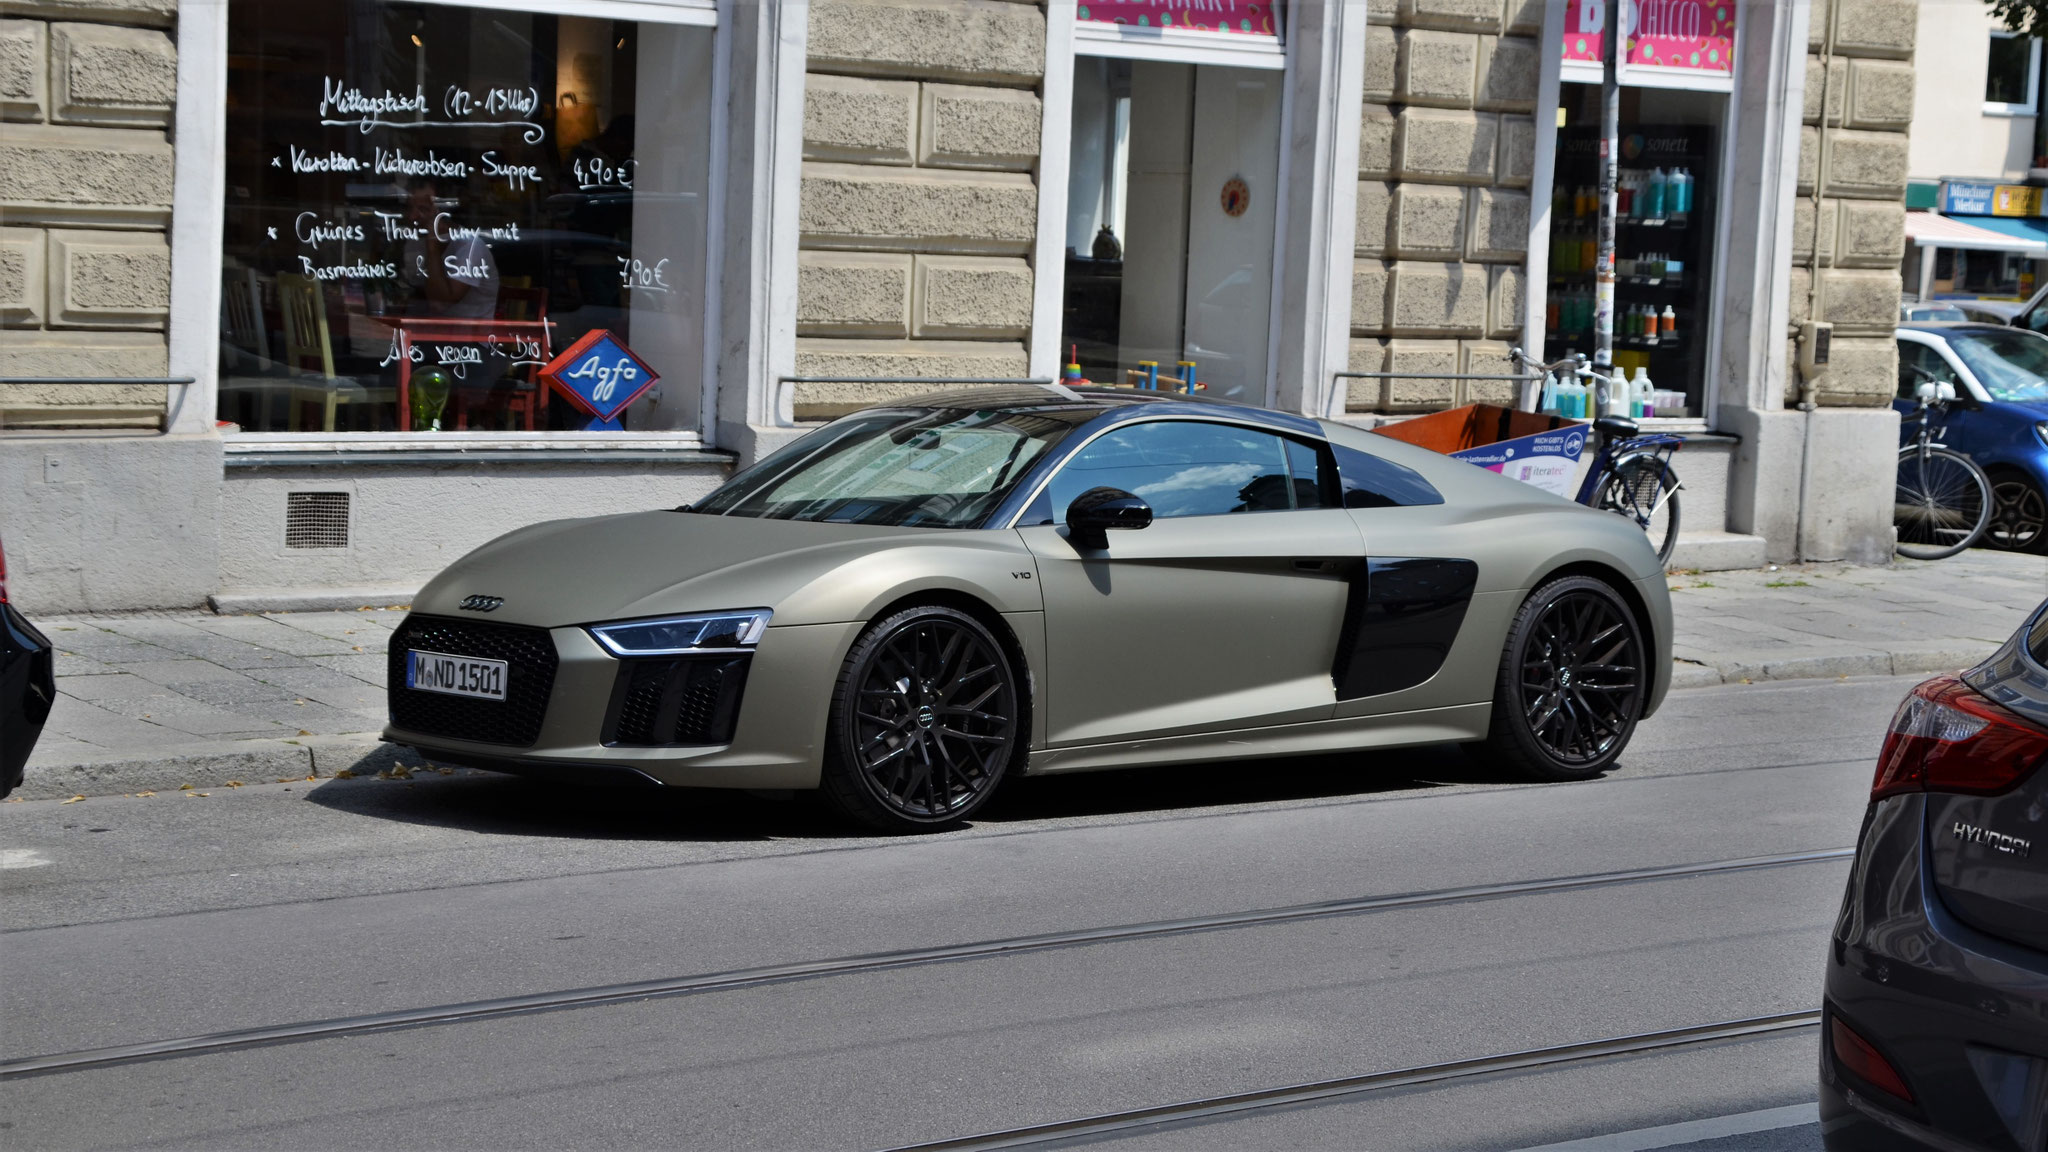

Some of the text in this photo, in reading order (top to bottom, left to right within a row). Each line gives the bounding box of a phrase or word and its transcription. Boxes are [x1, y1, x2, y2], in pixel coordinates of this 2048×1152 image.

[320, 75, 429, 135] Mittagstisch
[1566, 138, 1600, 152] sonet
[1646, 137, 1689, 153] sonett
[295, 211, 365, 250] Grünes
[491, 222, 521, 241] mit
[298, 254, 398, 282] Basmatireis
[444, 255, 491, 279] Salat
[617, 255, 670, 287] 7,90€
[379, 327, 425, 367] Alles
[435, 344, 484, 380] vegan
[568, 355, 638, 402] Agfa
[1532, 444, 1562, 452] KOSTENLOS
[1011, 571, 1032, 580] V10
[415, 656, 425, 685] M
[458, 662, 502, 695] 1501
[1953, 821, 2031, 857] HYUNDAI
